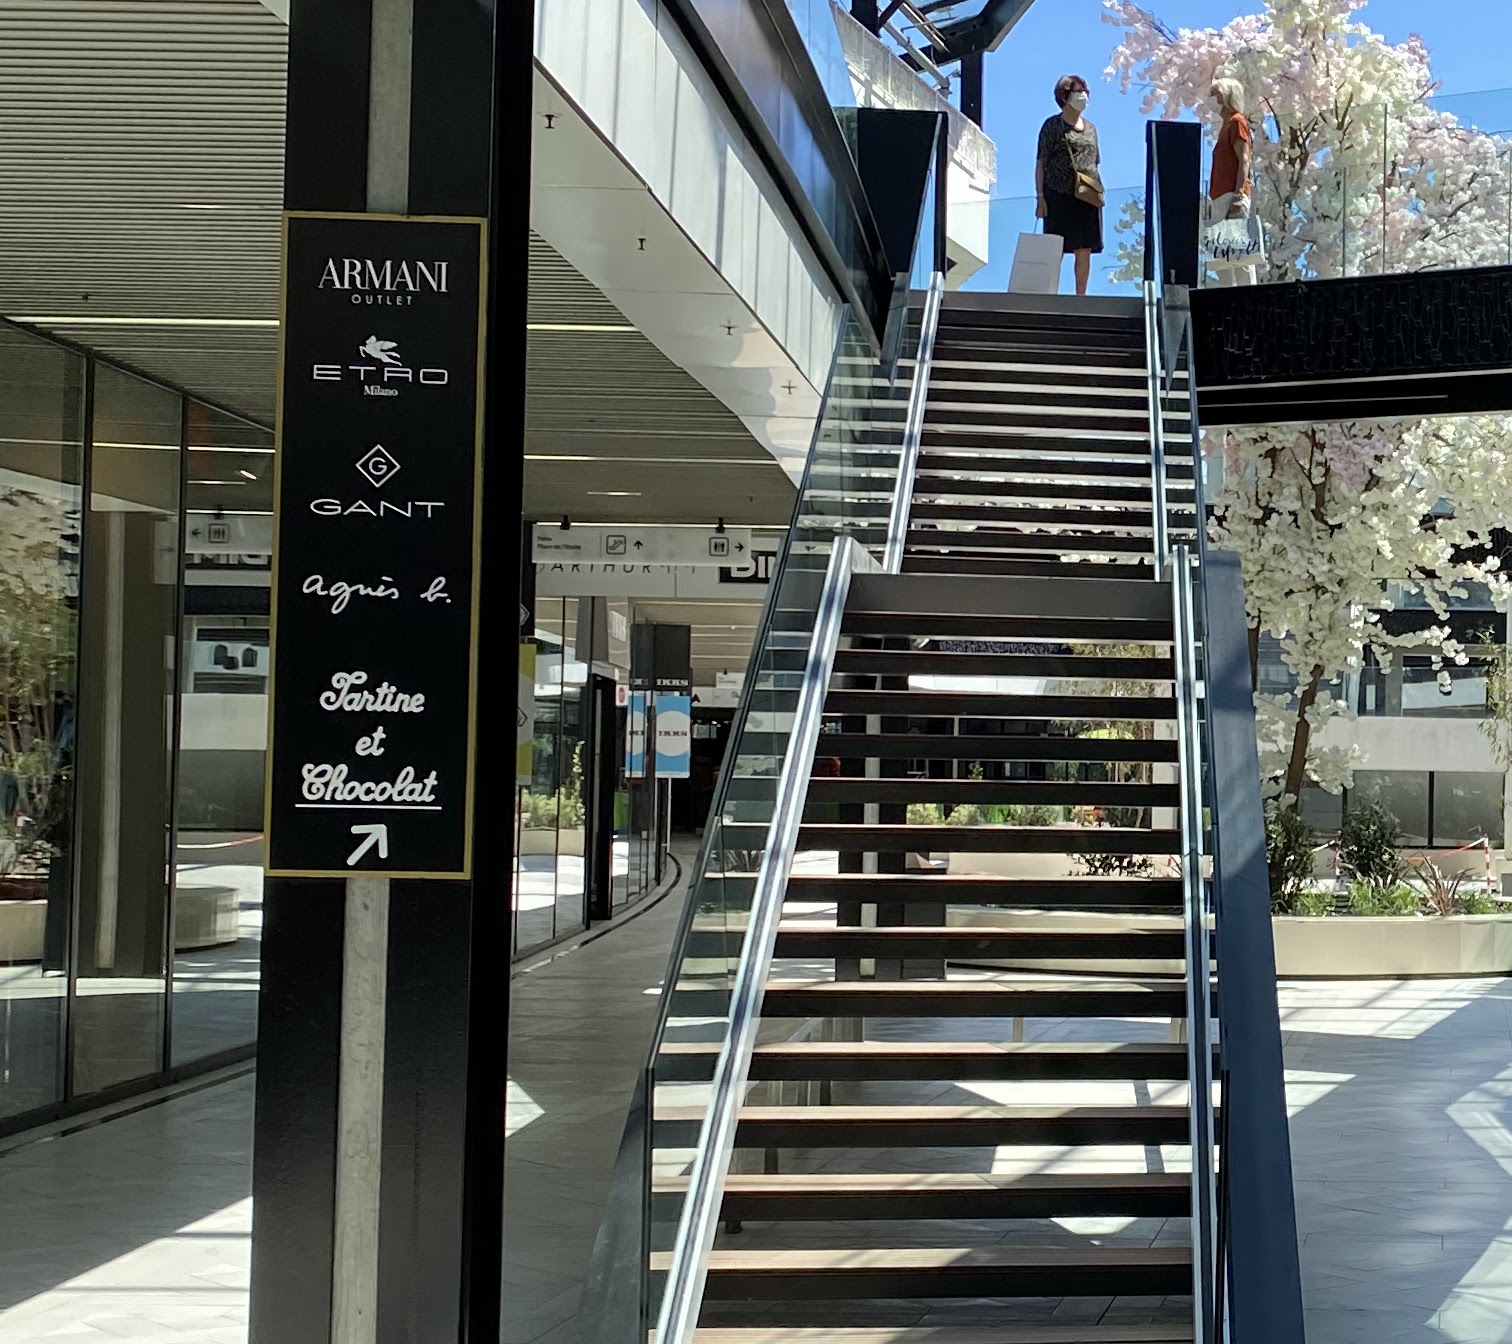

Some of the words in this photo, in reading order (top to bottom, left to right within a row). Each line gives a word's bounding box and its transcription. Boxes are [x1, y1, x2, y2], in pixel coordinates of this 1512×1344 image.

[318, 258, 449, 292] ARMANI
[351, 294, 413, 306] OUTLET
[364, 384, 399, 397] Milano
[368, 457, 388, 476] G
[310, 498, 445, 517] GANT
[303, 574, 400, 614] agnès
[421, 577, 451, 603] b.
[319, 671, 425, 713] Tartine
[355, 726, 386, 756] et
[302, 764, 438, 803] Chocolat
